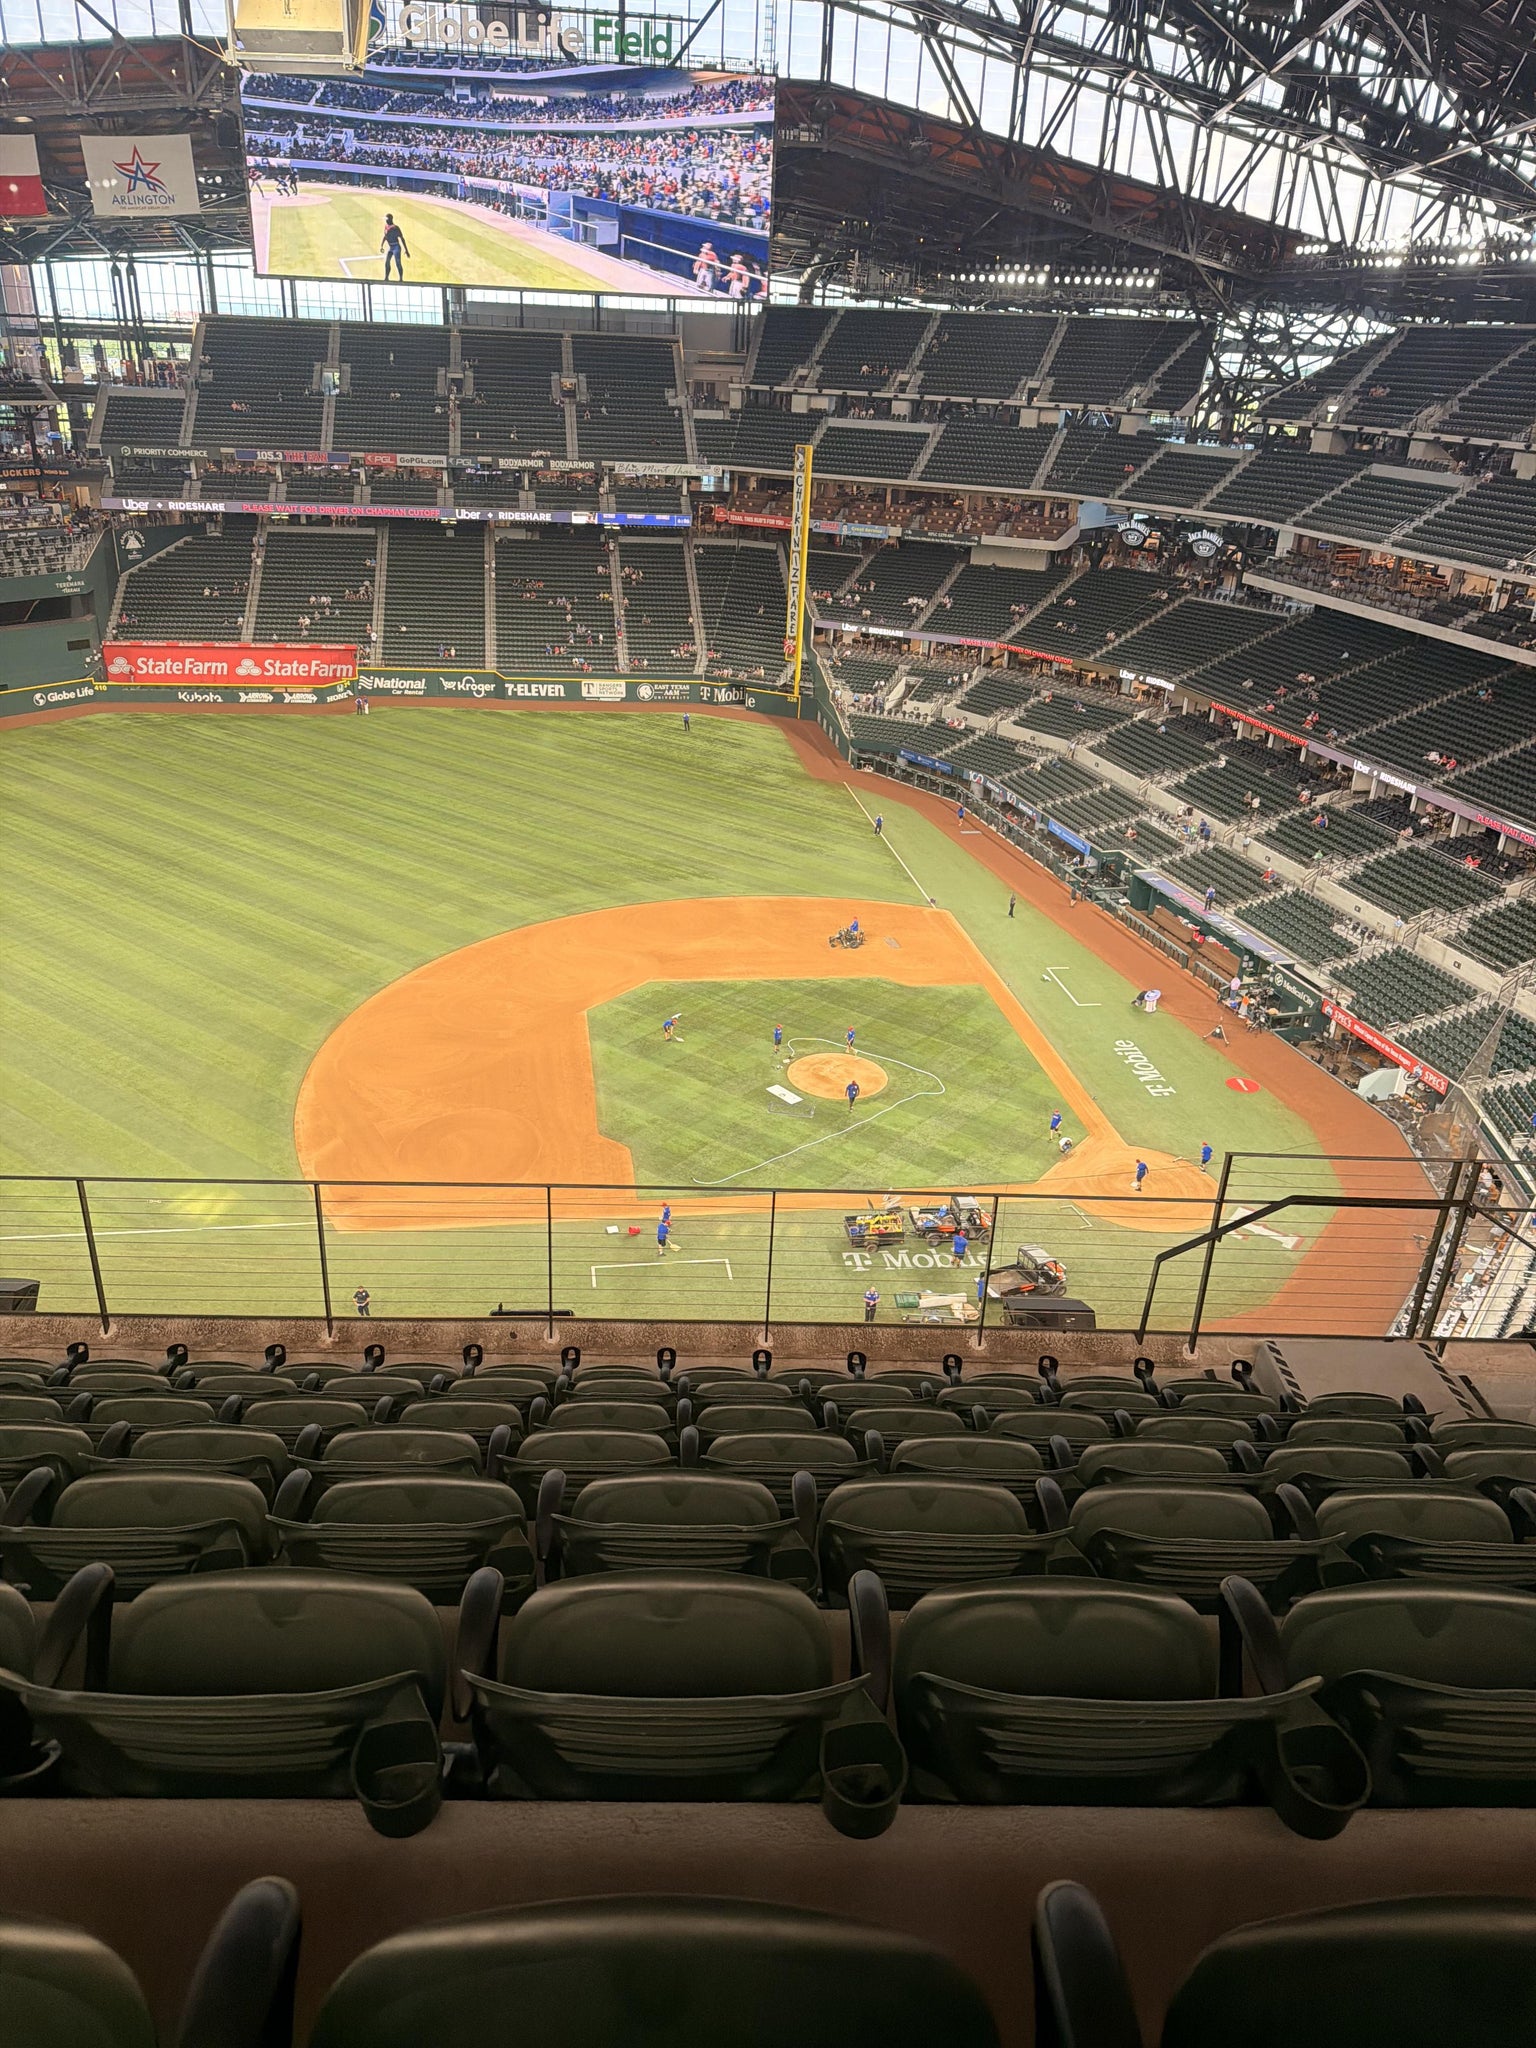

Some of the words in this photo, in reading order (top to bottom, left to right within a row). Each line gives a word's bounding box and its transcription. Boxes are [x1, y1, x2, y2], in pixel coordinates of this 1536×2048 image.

[400, 4, 509, 48] Globe
[518, 11, 584, 53] Life
[592, 19, 673, 59] Field
[112, 194, 176, 206] ARLINGTON
[133, 447, 166, 456] PRIORITY
[168, 449, 208, 458] COMMERCE
[256, 450, 283, 461] 105.3
[399, 457, 444, 466] GoPGL.com
[499, 458, 544, 469] BODYARMOR
[550, 460, 595, 471] BODYARMOR
[122, 499, 149, 511] Uber
[169, 501, 226, 512] RIDESHARE
[242, 503, 274, 512] PLEASE
[276, 504, 298, 512] WAIT
[300, 505, 318, 513] FOR
[320, 506, 349, 514] DRIVER
[350, 507, 364, 515] ON
[365, 507, 405, 516] CHAPMAN
[408, 508, 440, 517] CUTOFF
[455, 508, 481, 520] Uber
[498, 511, 551, 521] RIDESHARE
[793, 475, 804, 550] CHIKIN
[788, 586, 799, 635] FARE
[94, 684, 107, 692] 410
[374, 676, 426, 690] National
[457, 676, 496, 698] Kroger
[47, 690, 76, 702] Globe
[77, 686, 94, 698] Life
[178, 691, 224, 703] Kubota
[1353, 759, 1371, 775] Uber
[1476, 814, 1501, 831] PLEASE
[1501, 824, 1520, 839] WAIT
[1520, 832, 1535, 845] FOR
[1283, 979, 1304, 1001] Medical
[1302, 993, 1316, 1008] City
[1333, 1009, 1353, 1028] SPEC'S
[1423, 1070, 1447, 1092] SPEC'S
[1114, 1039, 1167, 1083] Mobile
